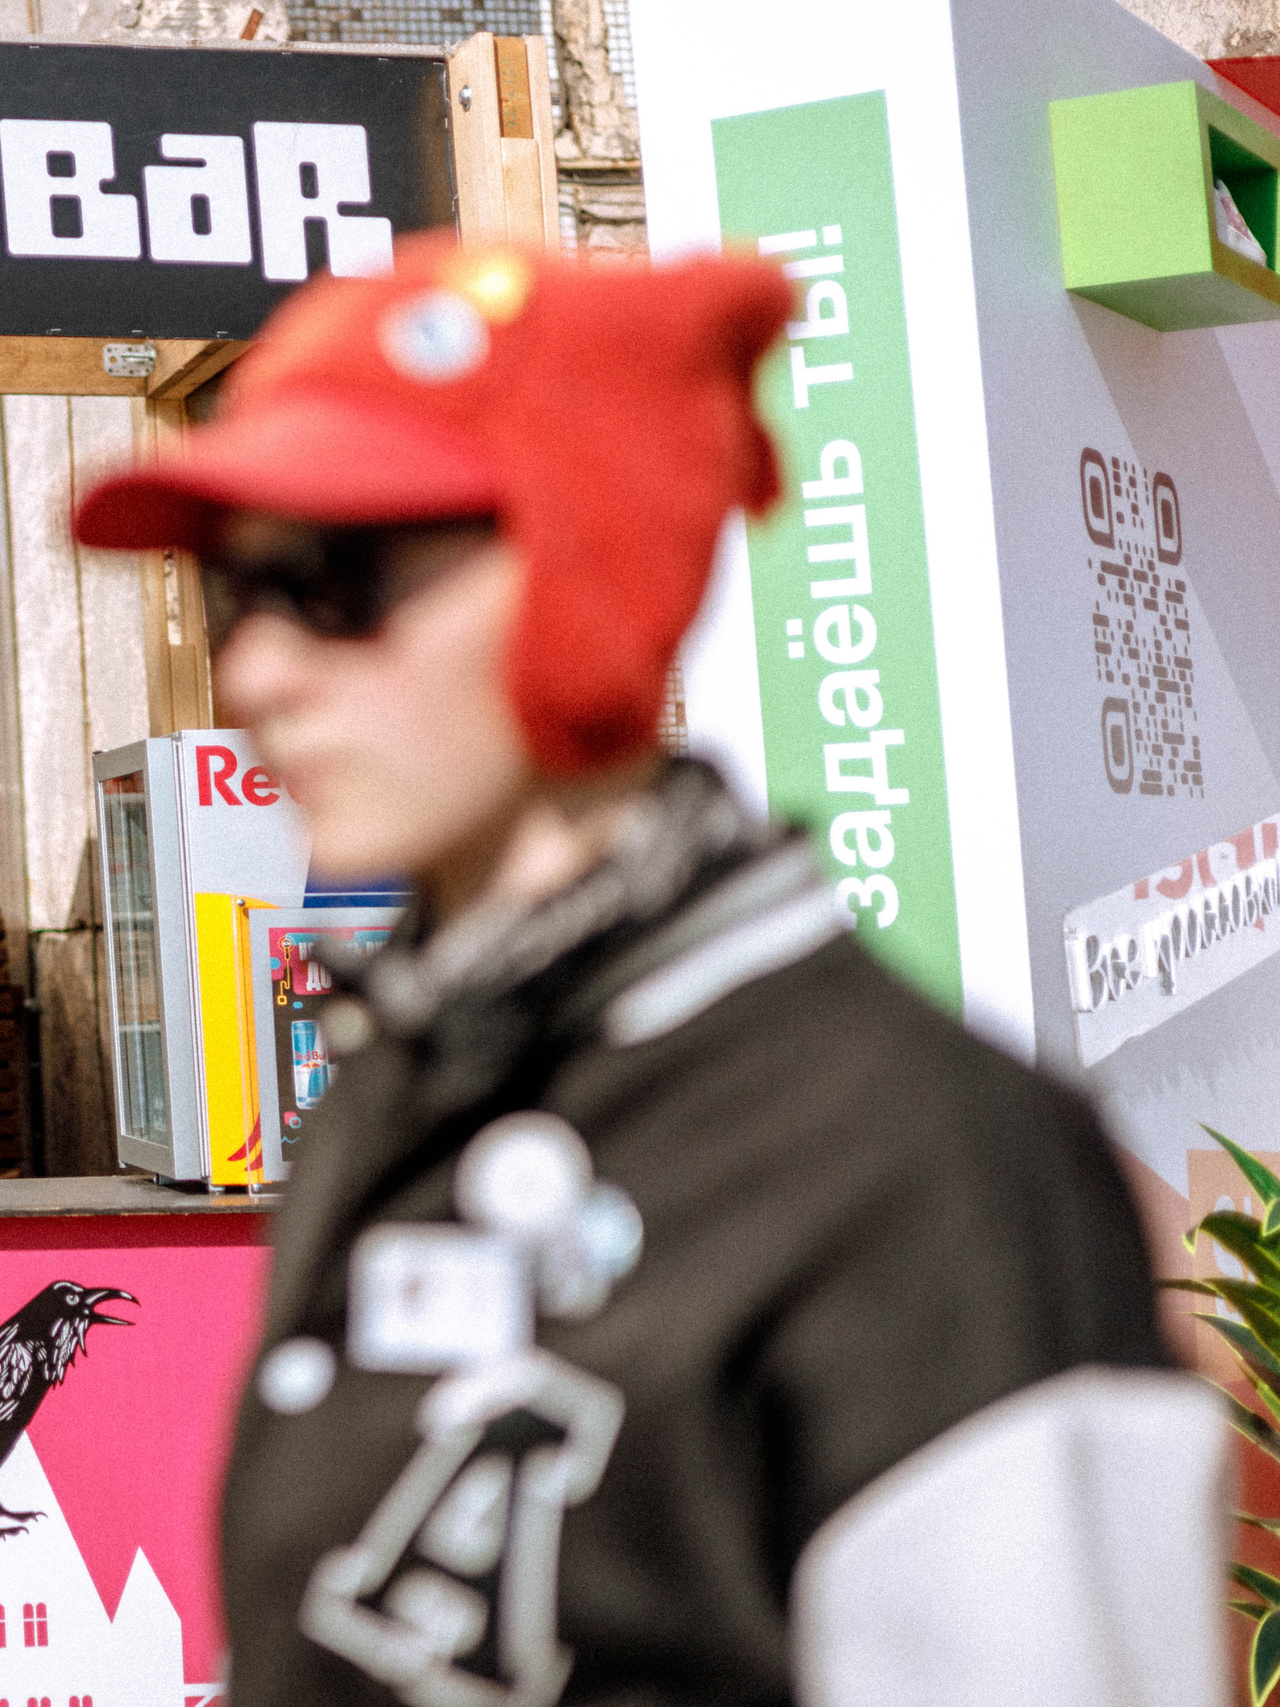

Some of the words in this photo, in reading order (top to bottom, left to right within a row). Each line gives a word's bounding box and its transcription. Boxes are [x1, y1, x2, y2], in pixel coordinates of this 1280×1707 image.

[757, 223, 854, 409] ты!
[195, 745, 286, 807] Re
[785, 438, 910, 930] задаёшь
